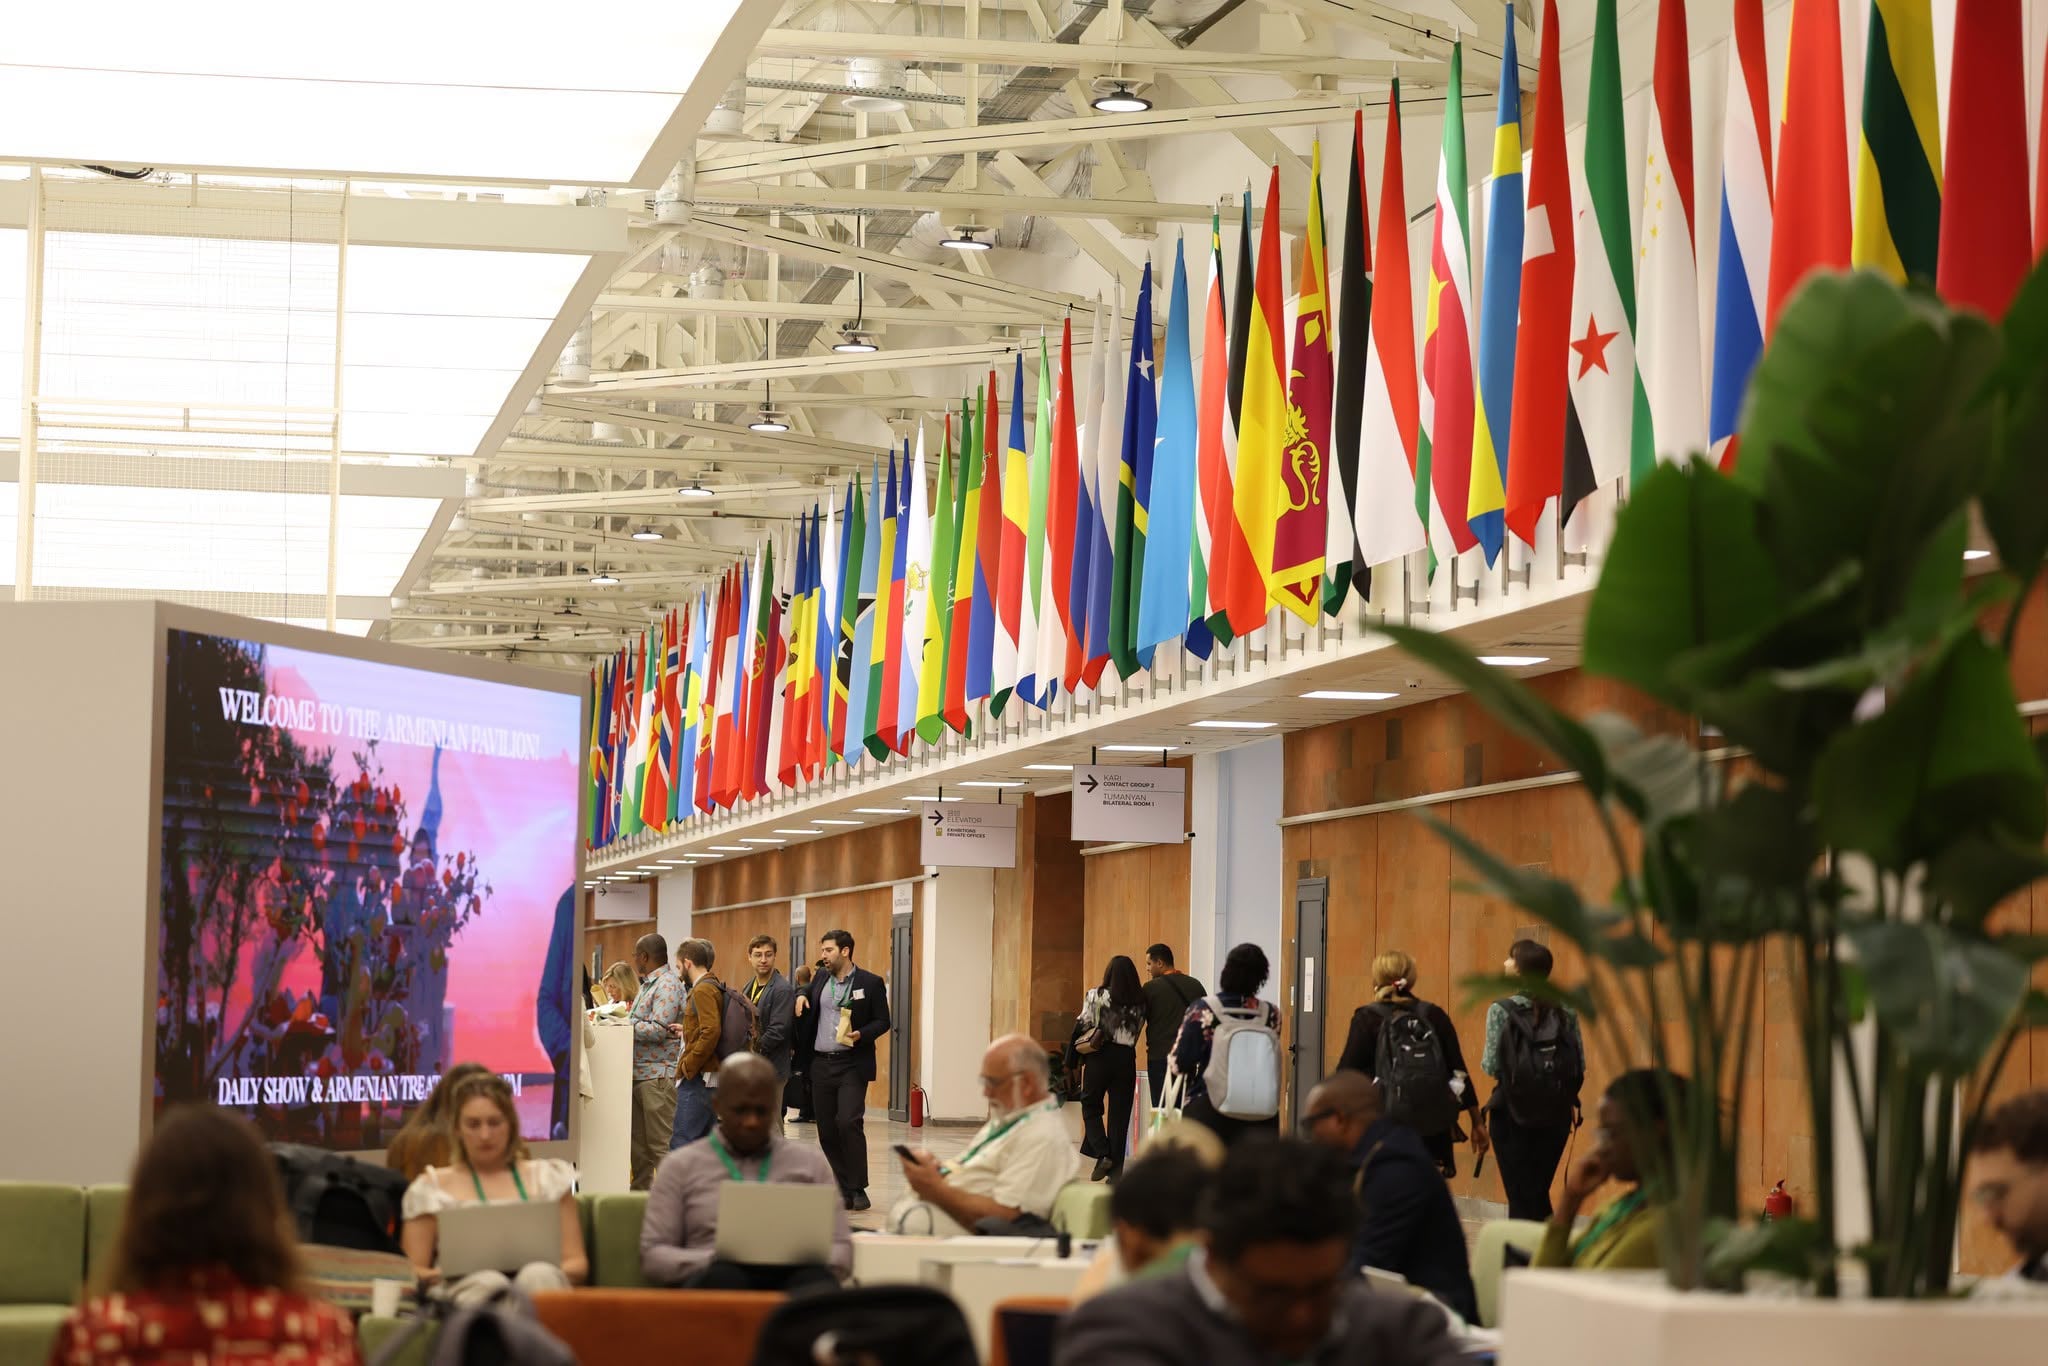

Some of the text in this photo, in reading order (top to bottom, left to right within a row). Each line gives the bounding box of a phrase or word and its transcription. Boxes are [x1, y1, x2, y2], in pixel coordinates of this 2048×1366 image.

[218, 686, 316, 731] WELCOME
[319, 702, 343, 735] TO
[346, 706, 381, 740] THE
[383, 712, 469, 752] ARMENIAN
[1103, 793, 1147, 801] TUMANYAN
[218, 1077, 262, 1105] DAILY
[263, 1076, 310, 1104] SHOW
[311, 1075, 323, 1103] &
[324, 1075, 399, 1102] ARMENIAN
